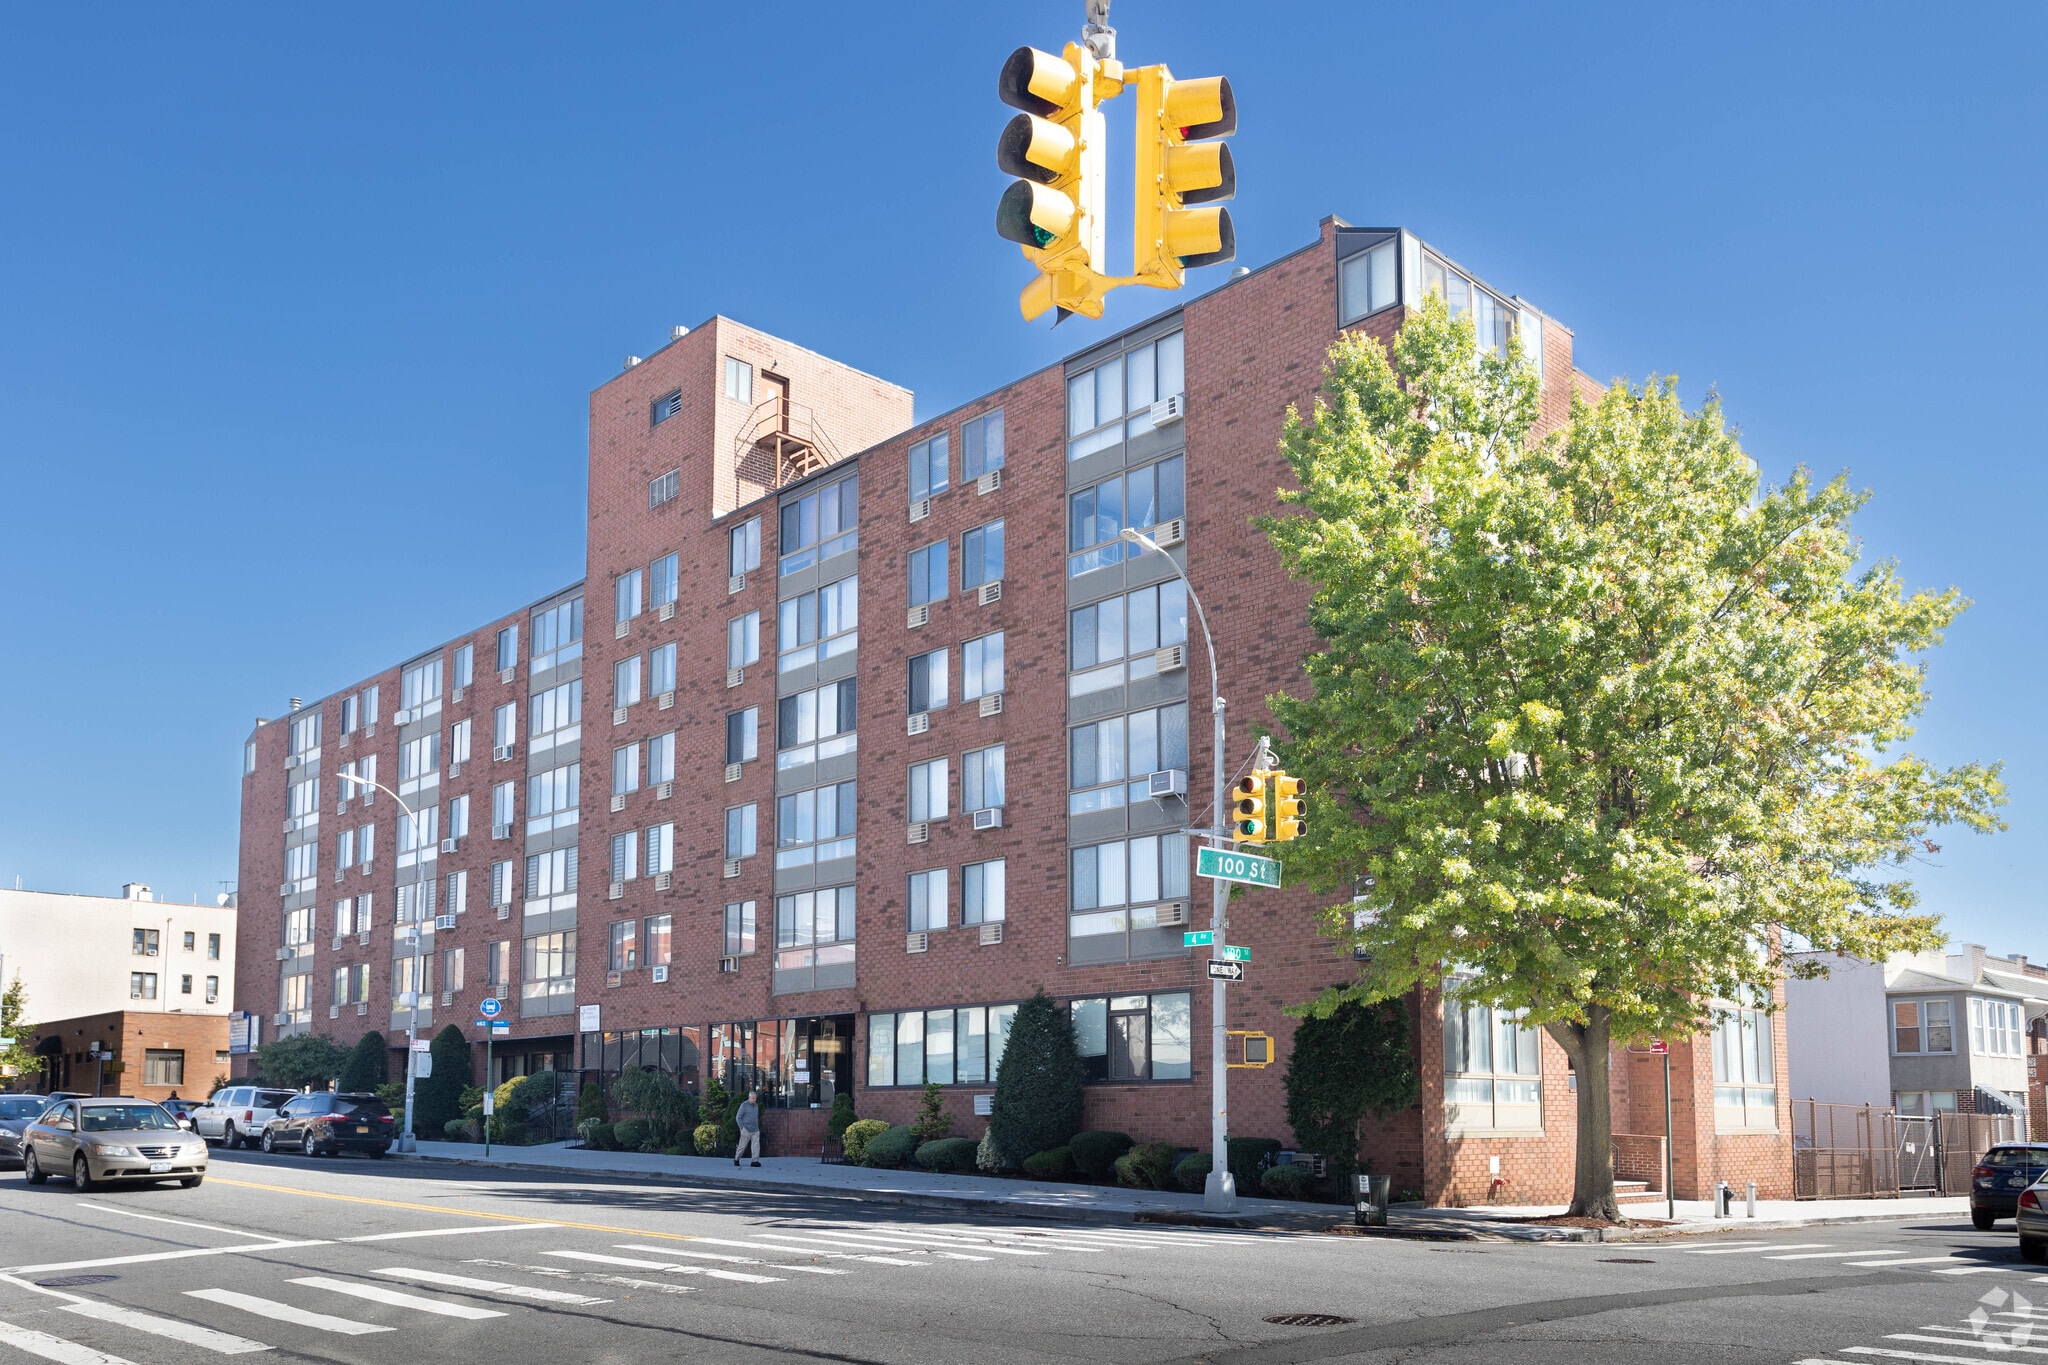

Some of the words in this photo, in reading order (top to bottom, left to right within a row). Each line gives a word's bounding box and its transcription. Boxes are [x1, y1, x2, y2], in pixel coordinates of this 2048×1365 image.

[1218, 856, 1245, 876] 100
[1249, 861, 1266, 879] St
[1191, 933, 1197, 945] 4
[1213, 966, 1223, 974] ONE
[1227, 966, 1238, 975] WAY
